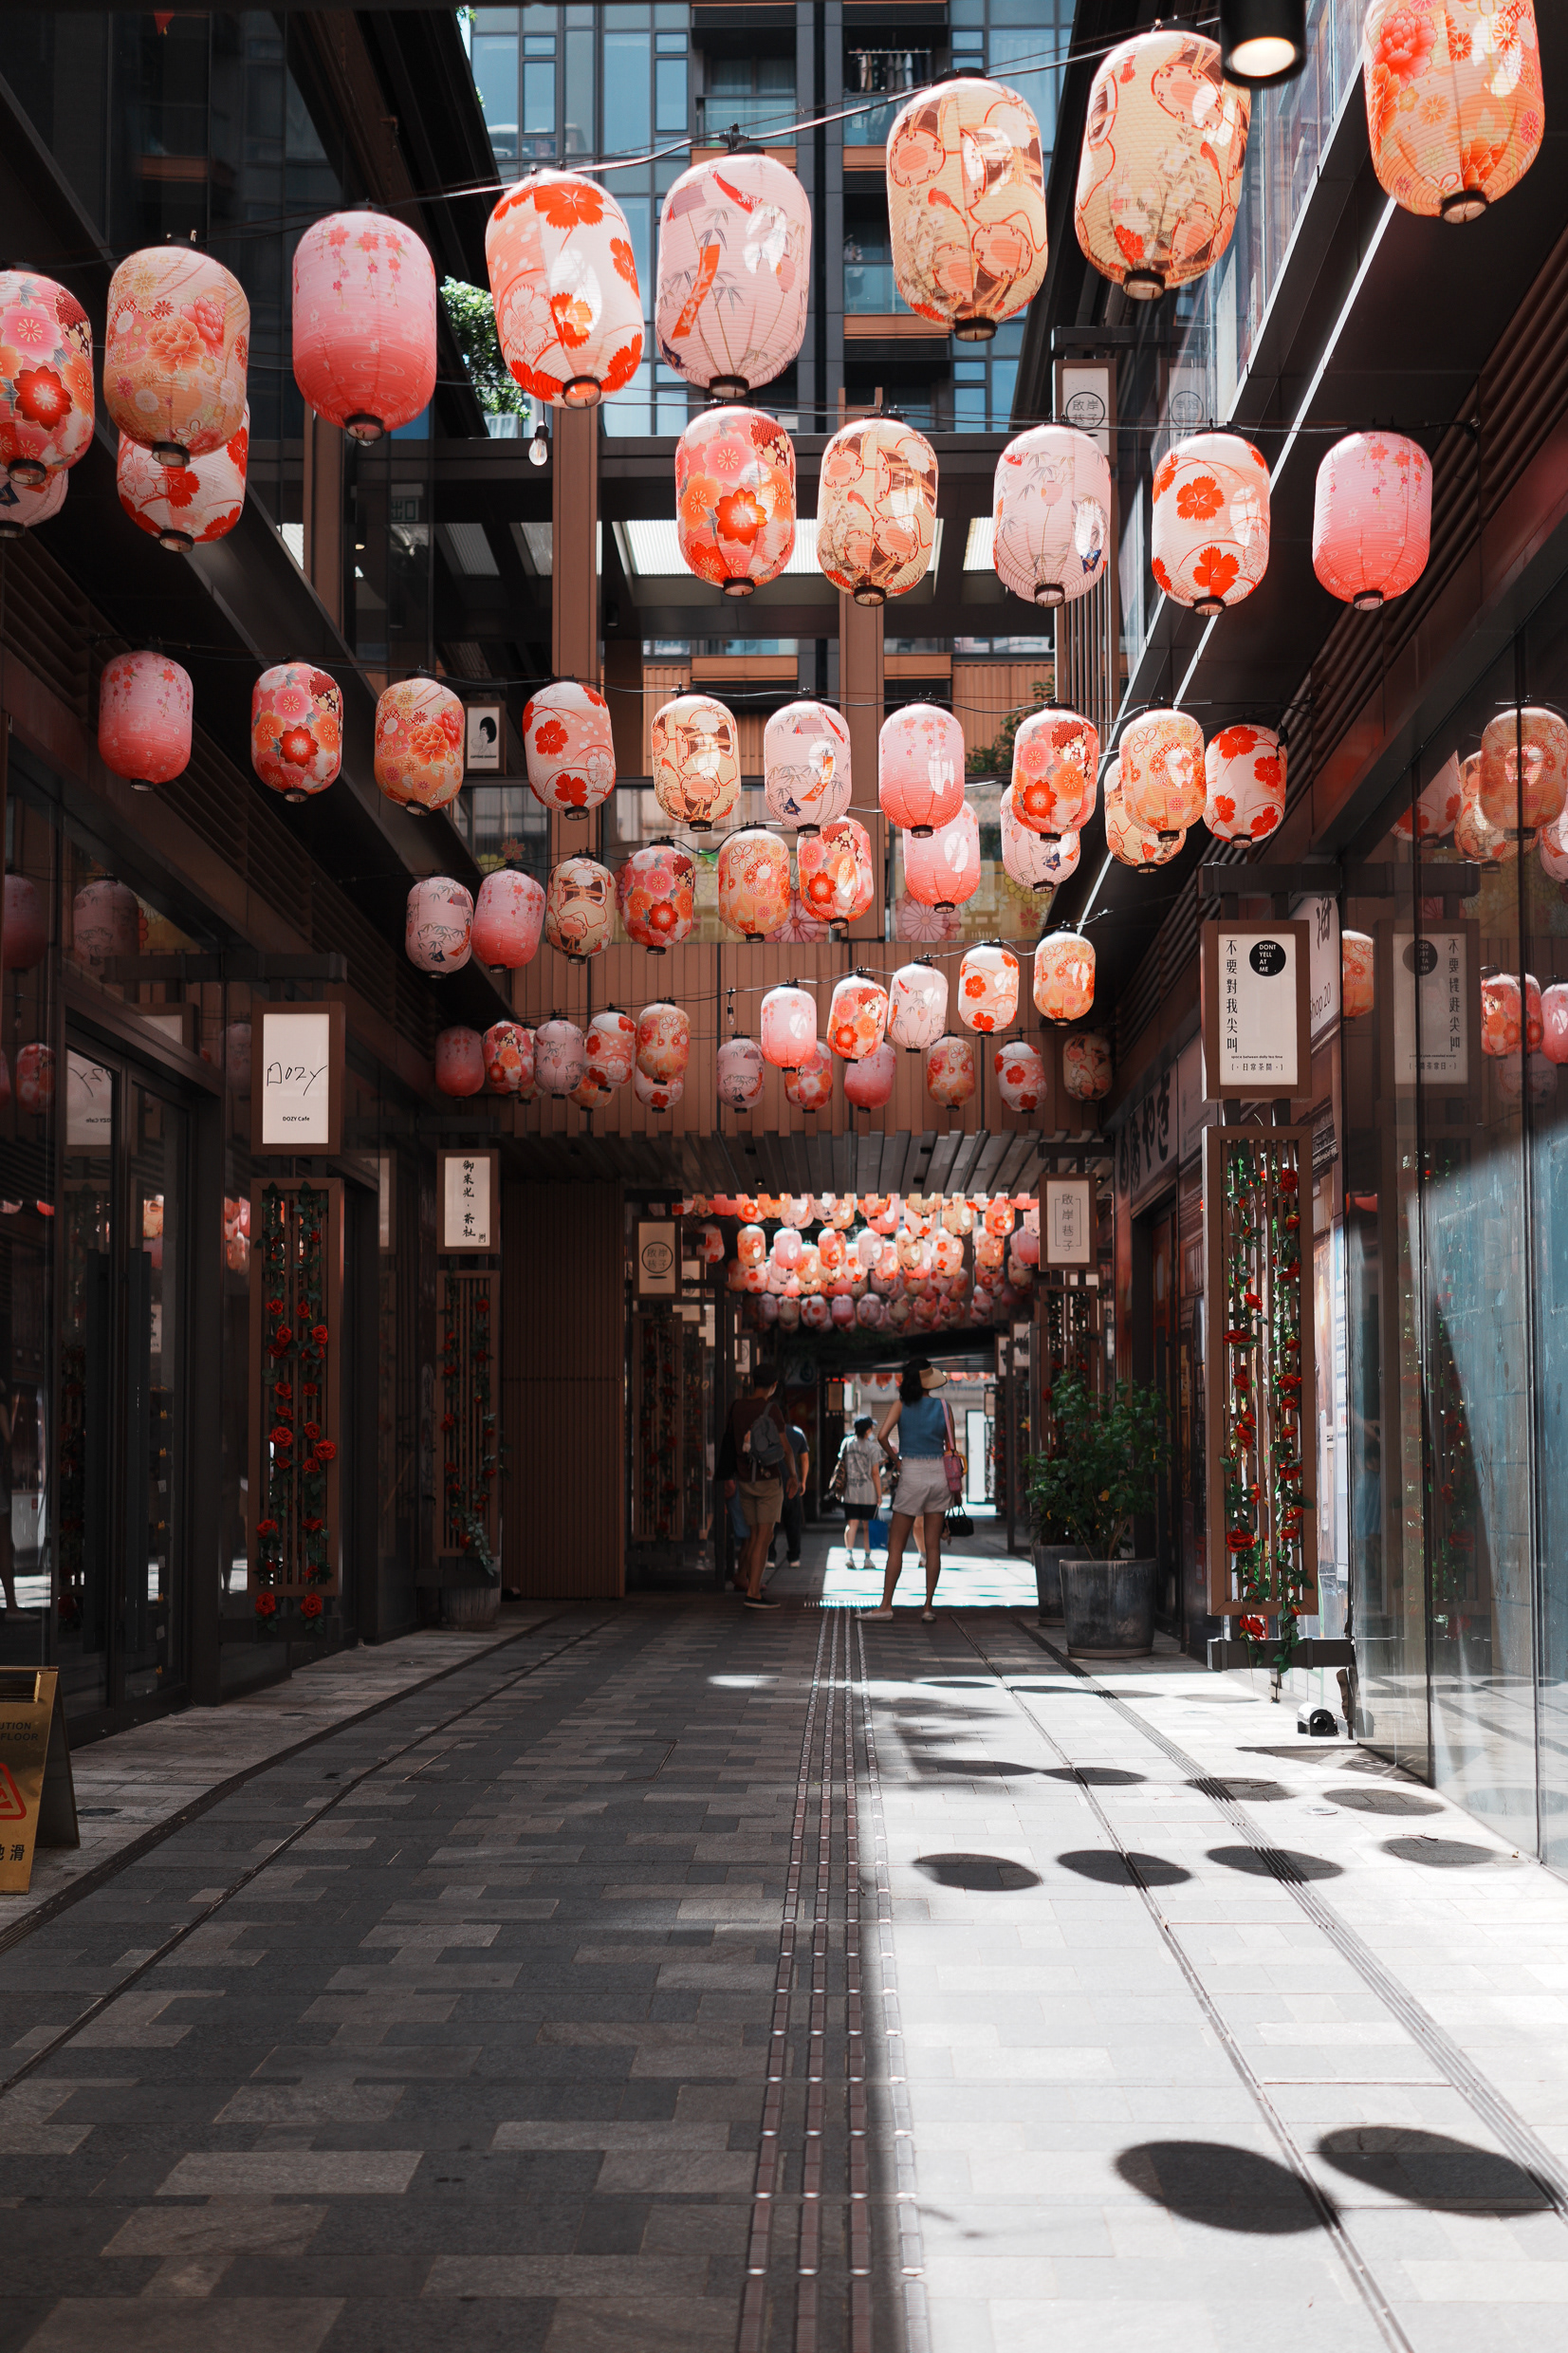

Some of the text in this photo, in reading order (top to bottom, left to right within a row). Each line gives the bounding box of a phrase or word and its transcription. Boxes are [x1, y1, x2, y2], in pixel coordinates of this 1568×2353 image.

[1226, 939, 1238, 1053] 不要對我尖叫
[1310, 982, 1332, 1021] hop 20
[0, 1732, 39, 1741] FLOOR
